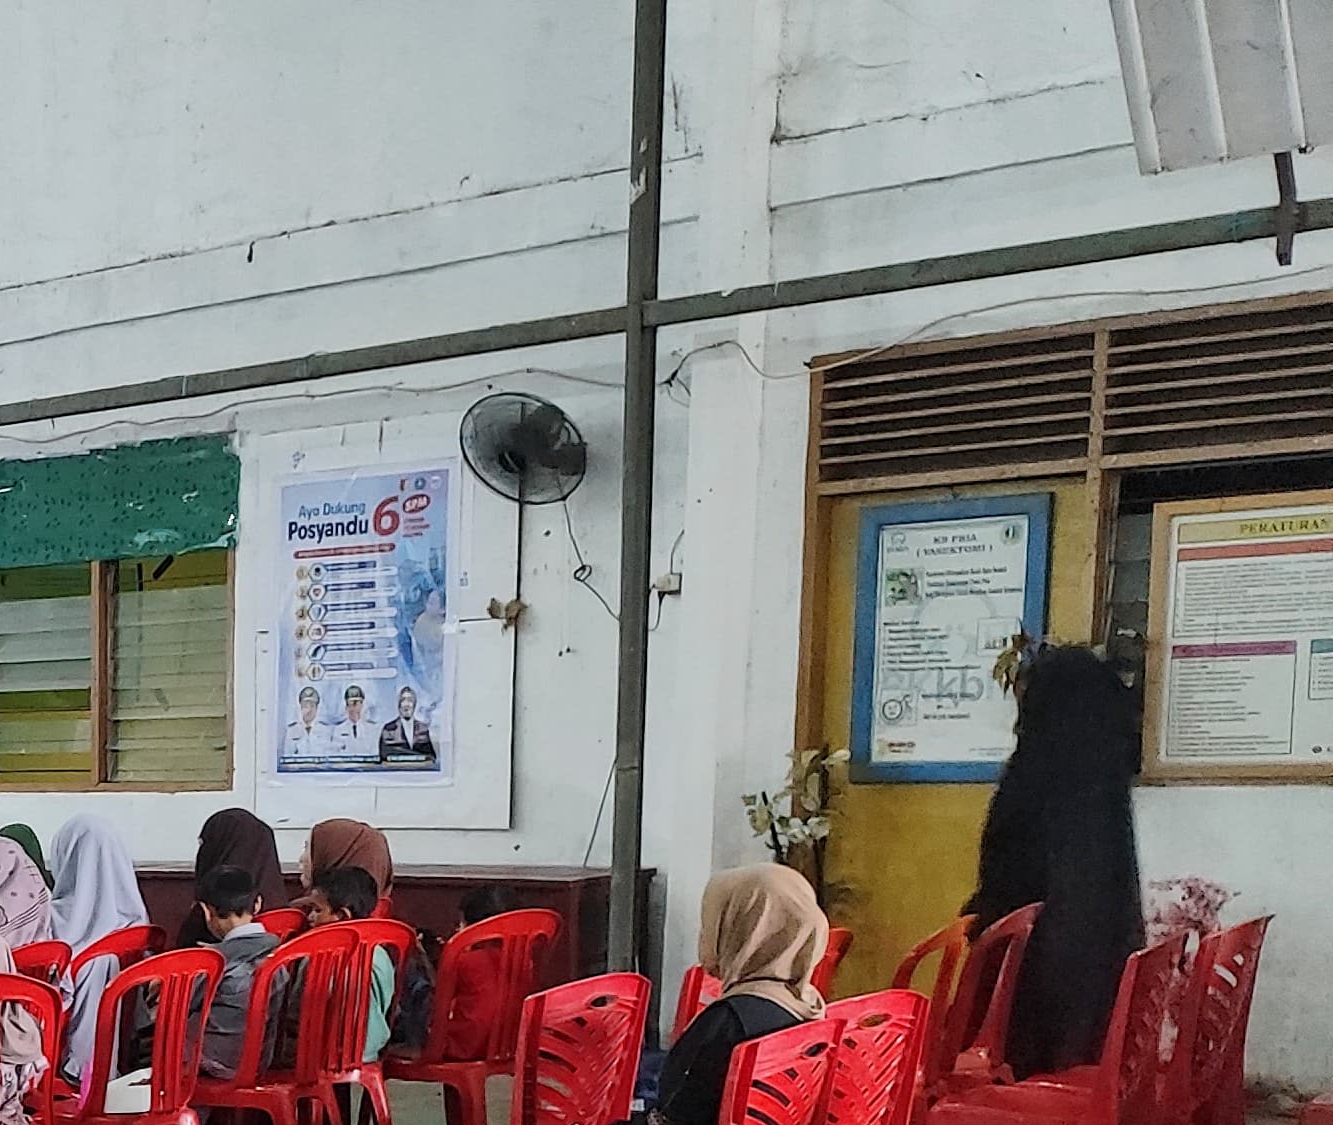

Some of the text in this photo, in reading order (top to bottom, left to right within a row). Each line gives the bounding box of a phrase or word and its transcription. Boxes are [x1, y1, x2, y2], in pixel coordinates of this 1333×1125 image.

[322, 501, 366, 516] Dukung
[372, 494, 400, 537] 6
[288, 515, 369, 544] Posyandu
